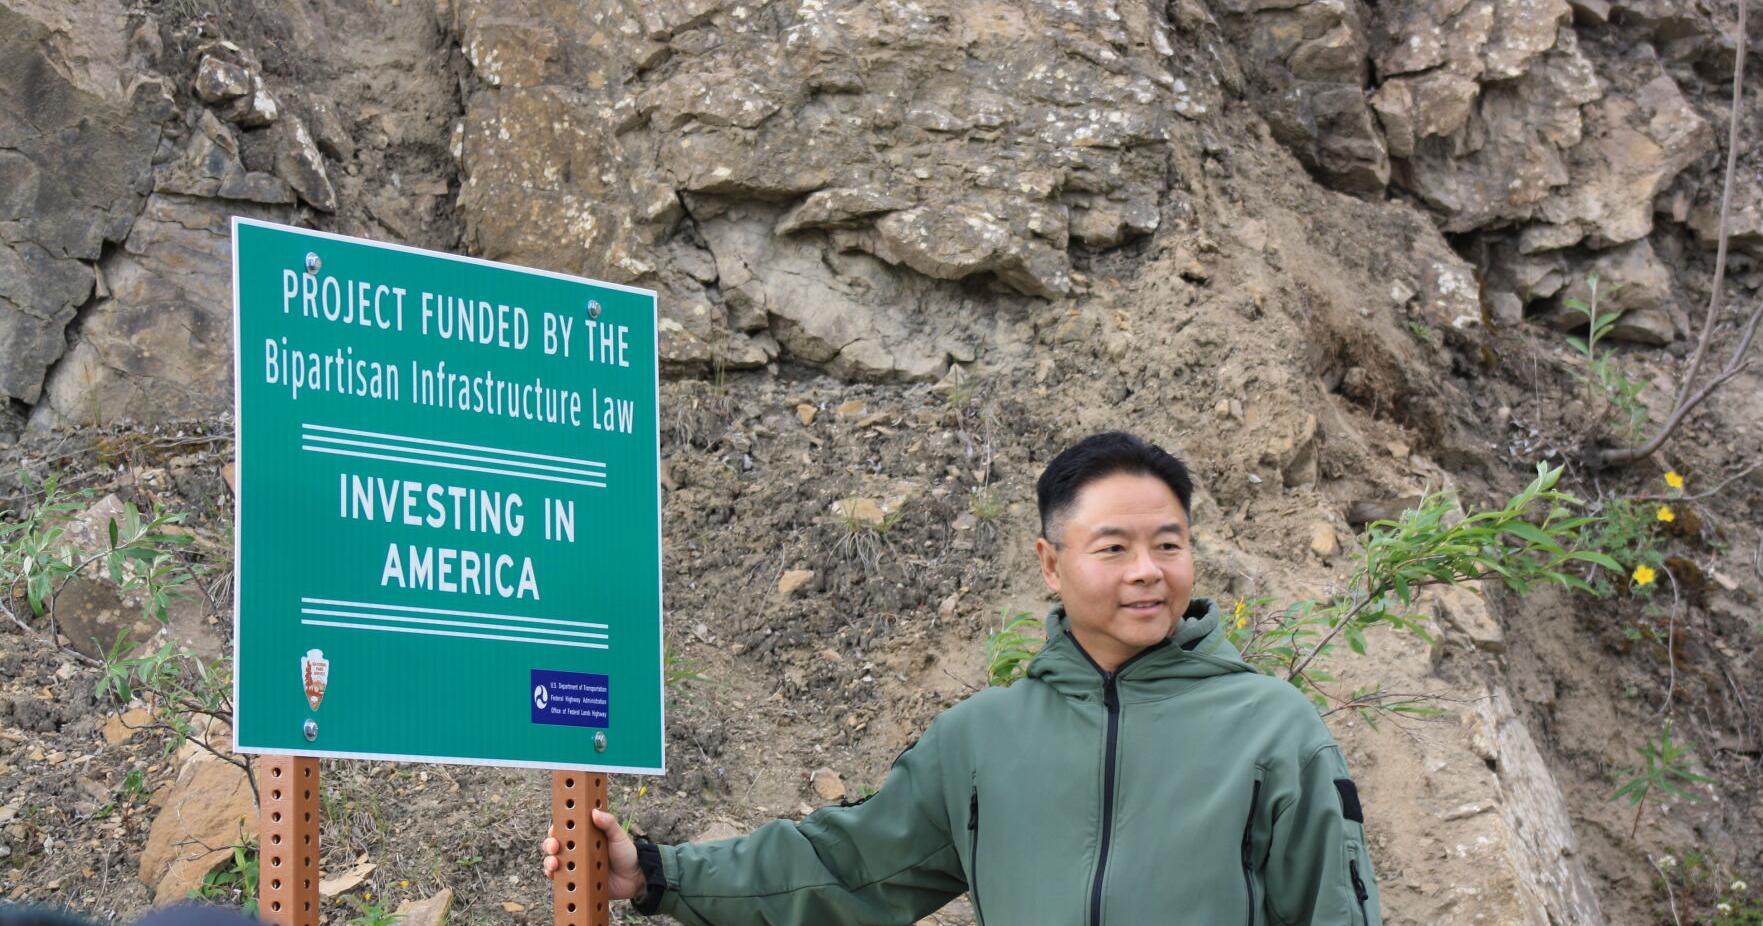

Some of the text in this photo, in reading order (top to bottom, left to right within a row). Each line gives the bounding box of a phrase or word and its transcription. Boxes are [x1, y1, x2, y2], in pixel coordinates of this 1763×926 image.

[283, 269, 630, 368] PROJECT FUNDED BY THE
[265, 338, 634, 434] Bipartisan Infrastructure Law
[340, 473, 575, 543] INVESTING IN
[380, 543, 540, 601] AMERICA
[565, 696, 581, 704] Highway
[583, 684, 607, 692] Transportation
[592, 710, 607, 719] Highway
